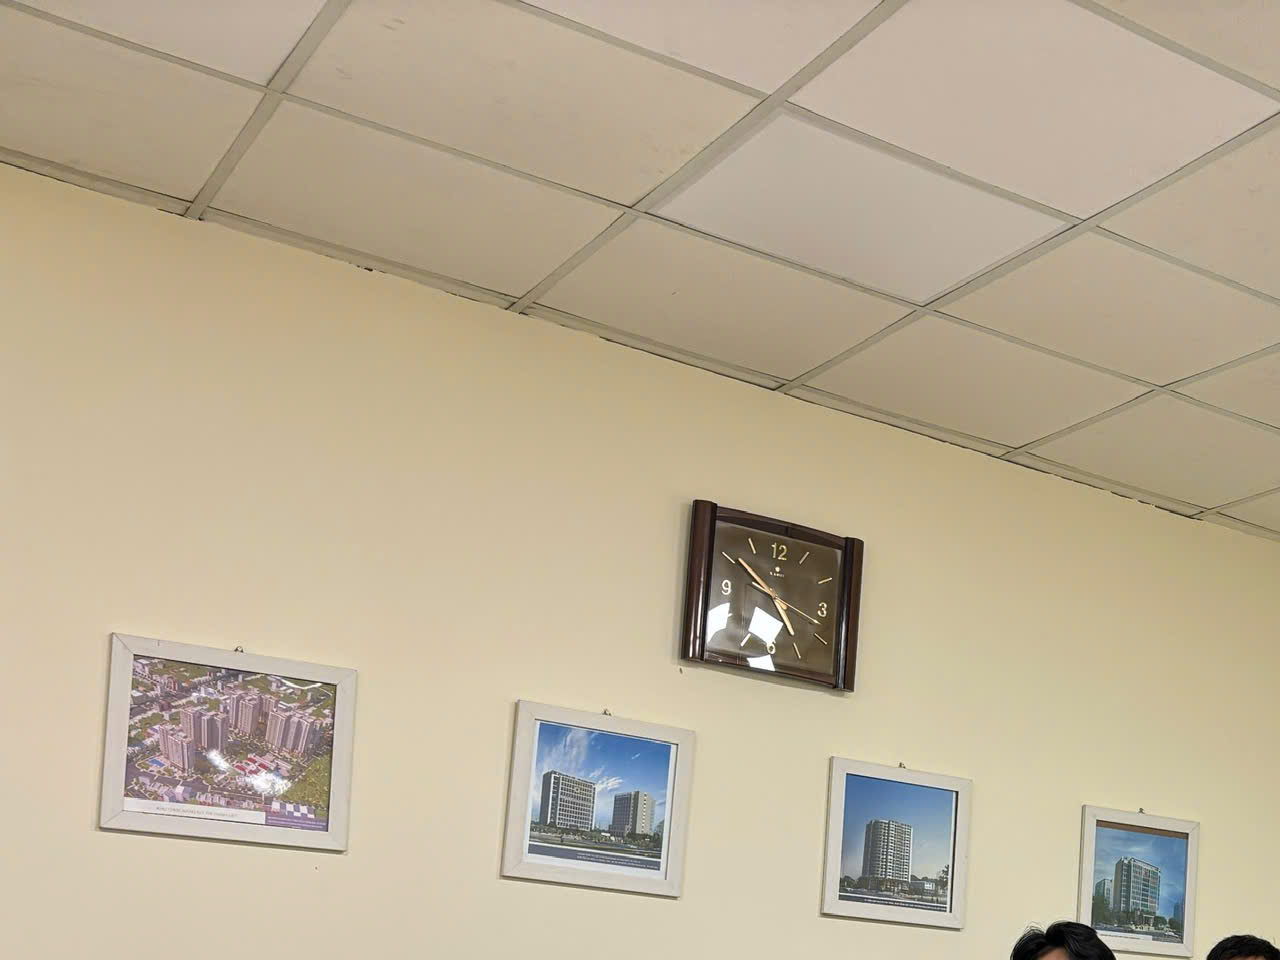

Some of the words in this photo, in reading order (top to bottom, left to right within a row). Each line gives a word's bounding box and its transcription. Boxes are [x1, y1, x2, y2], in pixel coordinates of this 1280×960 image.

[771, 542, 788, 561] 12
[721, 579, 732, 596] 9
[817, 602, 828, 617] 3
[767, 639, 776, 655] 6
